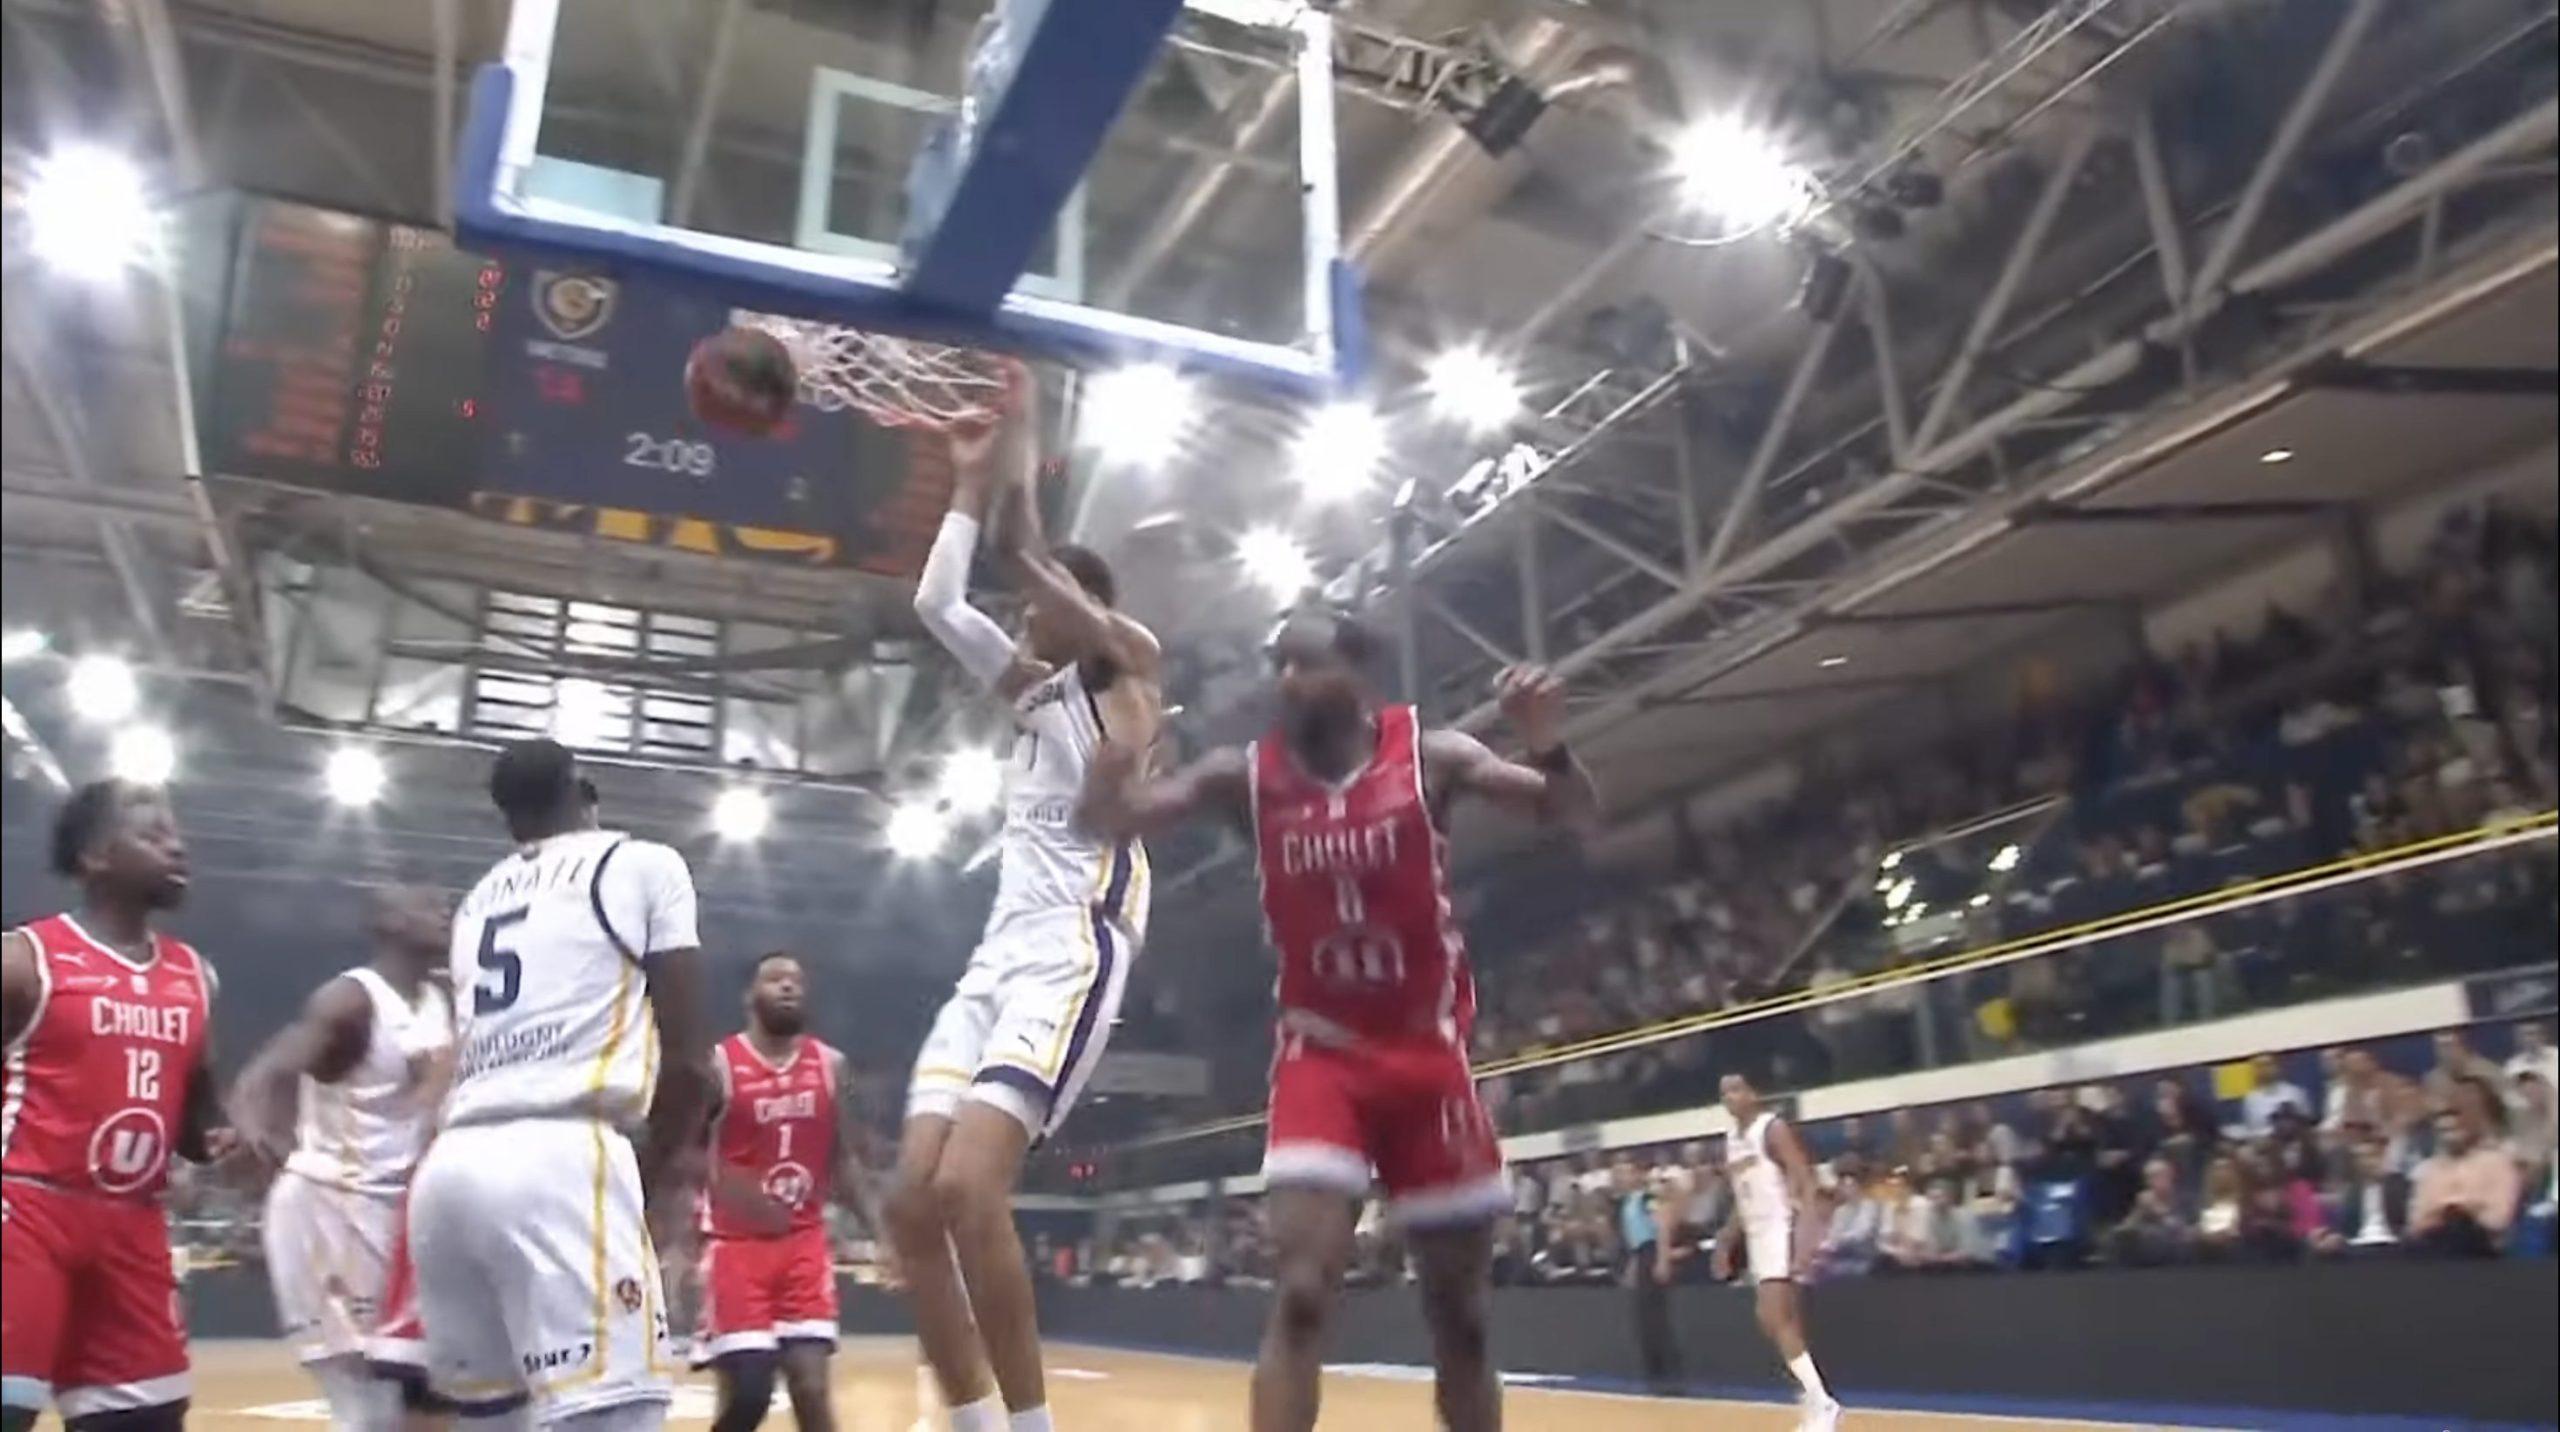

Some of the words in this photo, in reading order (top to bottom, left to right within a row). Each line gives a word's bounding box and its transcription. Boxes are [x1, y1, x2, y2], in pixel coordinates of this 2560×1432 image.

[622, 431, 716, 476] 2:09
[473, 902, 531, 1017] 5
[91, 995, 191, 1046] CHOLET
[124, 1047, 162, 1101] 12
[109, 1130, 155, 1175] U
[779, 1123, 792, 1159] 1
